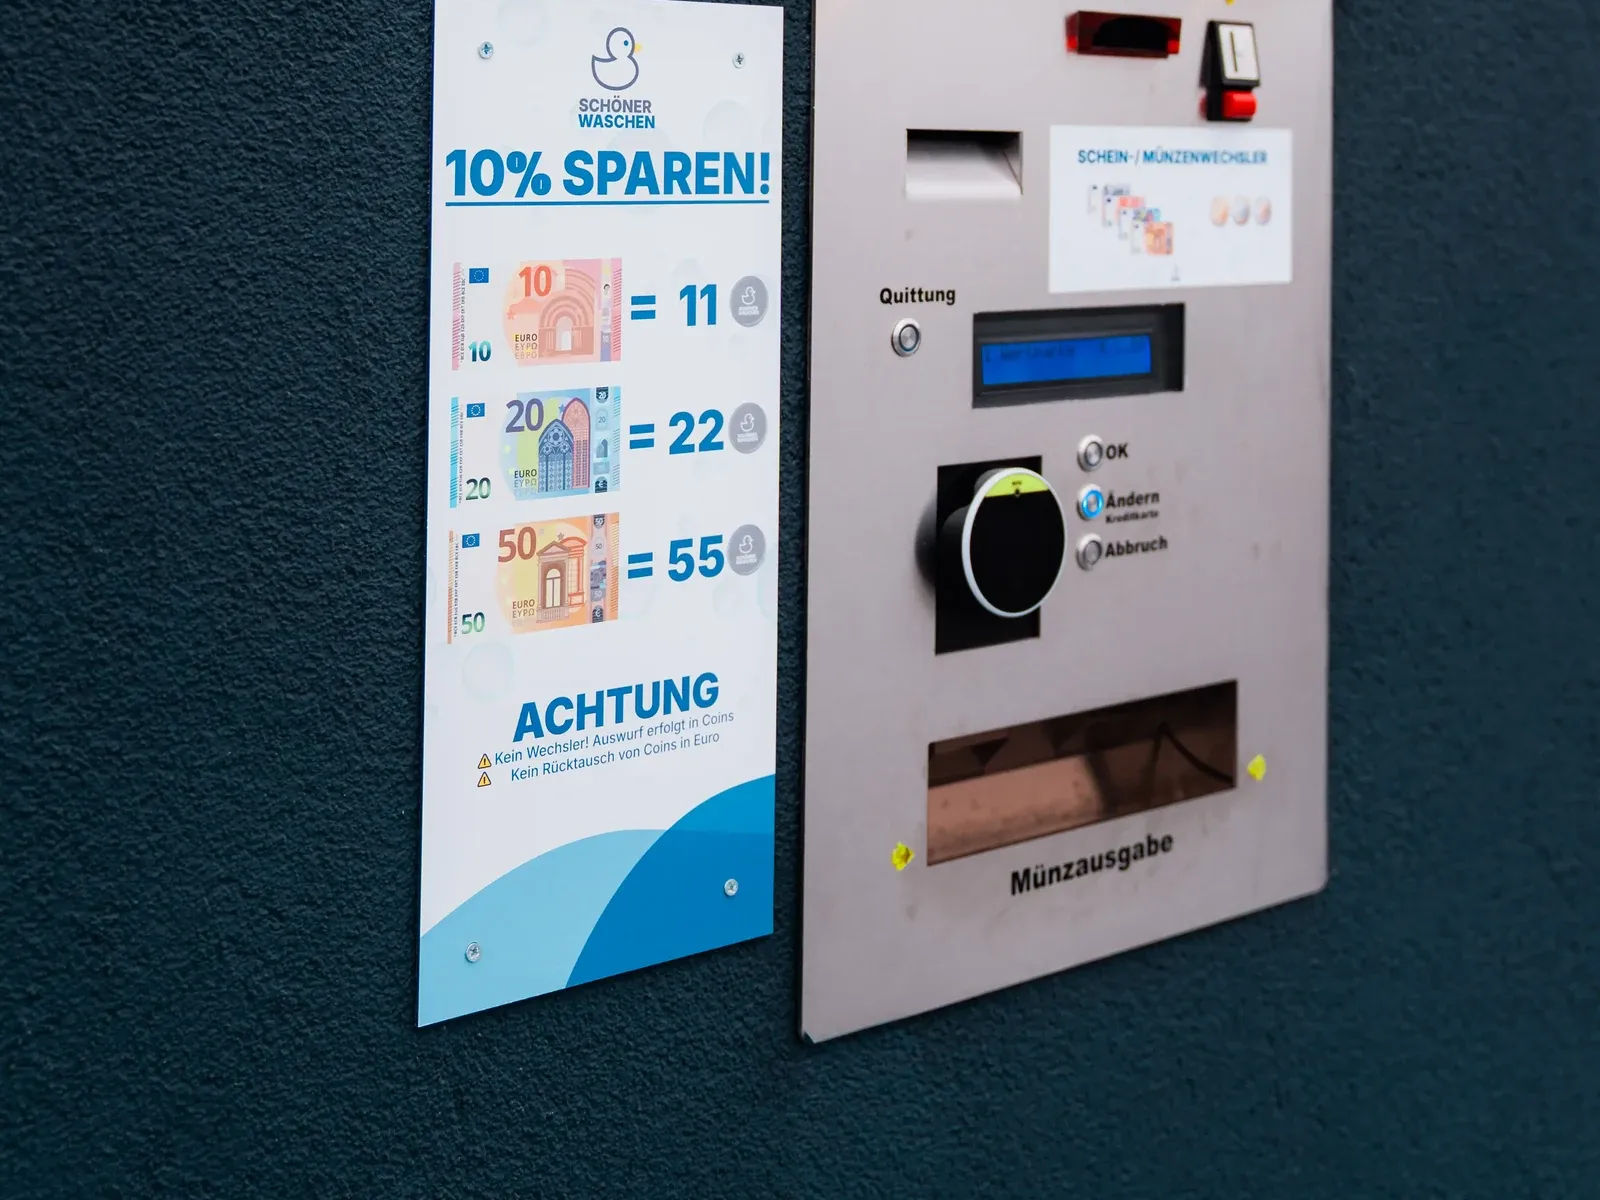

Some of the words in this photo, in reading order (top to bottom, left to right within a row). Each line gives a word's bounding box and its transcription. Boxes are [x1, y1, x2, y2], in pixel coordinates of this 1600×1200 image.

[578, 95, 652, 113] SCHÖNER
[578, 114, 656, 129] WASCHEN
[446, 149, 552, 198] 10%
[563, 150, 770, 196] SPAREN!
[519, 265, 552, 297] 10
[680, 284, 717, 327] 11
[880, 287, 956, 306] Quittung
[515, 333, 538, 343] EURO
[468, 341, 492, 362] 10
[506, 398, 544, 433] 20
[598, 416, 606, 424] 20
[669, 410, 724, 455] 22
[1106, 443, 1129, 461] OK
[514, 468, 538, 479] EURO
[465, 477, 491, 501] 20
[498, 526, 537, 563] 50
[1105, 535, 1168, 558] Abbruch
[668, 534, 724, 582] 55
[512, 598, 535, 610] EURO
[461, 611, 485, 634] 50
[512, 672, 719, 743] ACHTUNG
[495, 750, 523, 765] Kein
[526, 737, 589, 759] Wechsler!
[592, 725, 643, 748] Auswurf
[647, 718, 686, 737] erfolgt
[688, 717, 699, 730] in
[702, 711, 735, 727] Coins
[511, 765, 539, 782] Kein
[542, 752, 615, 775] Rücktausch
[618, 748, 641, 762] von
[643, 739, 677, 756] Coins
[680, 736, 691, 749] in
[694, 731, 720, 747] Euro
[1010, 833, 1174, 896] Münzausgabe
